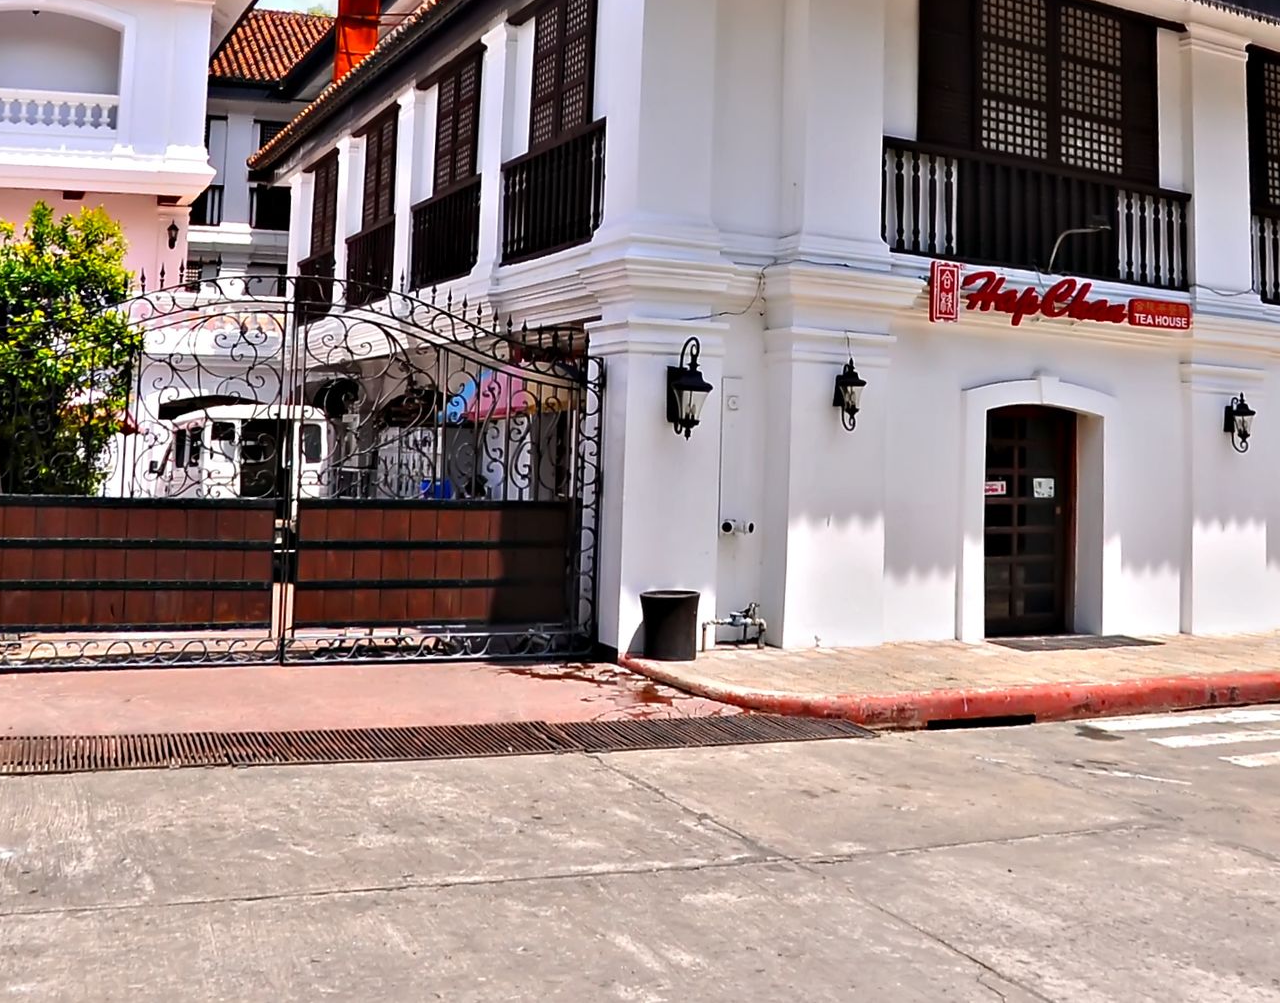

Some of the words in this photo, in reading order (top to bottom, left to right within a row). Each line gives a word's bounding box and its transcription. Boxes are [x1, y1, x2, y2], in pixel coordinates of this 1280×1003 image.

[960, 271, 1040, 326] Hap
[1039, 278, 1128, 323] Chan
[1134, 313, 1154, 325] TEA
[1155, 314, 1188, 328] HOUSE
